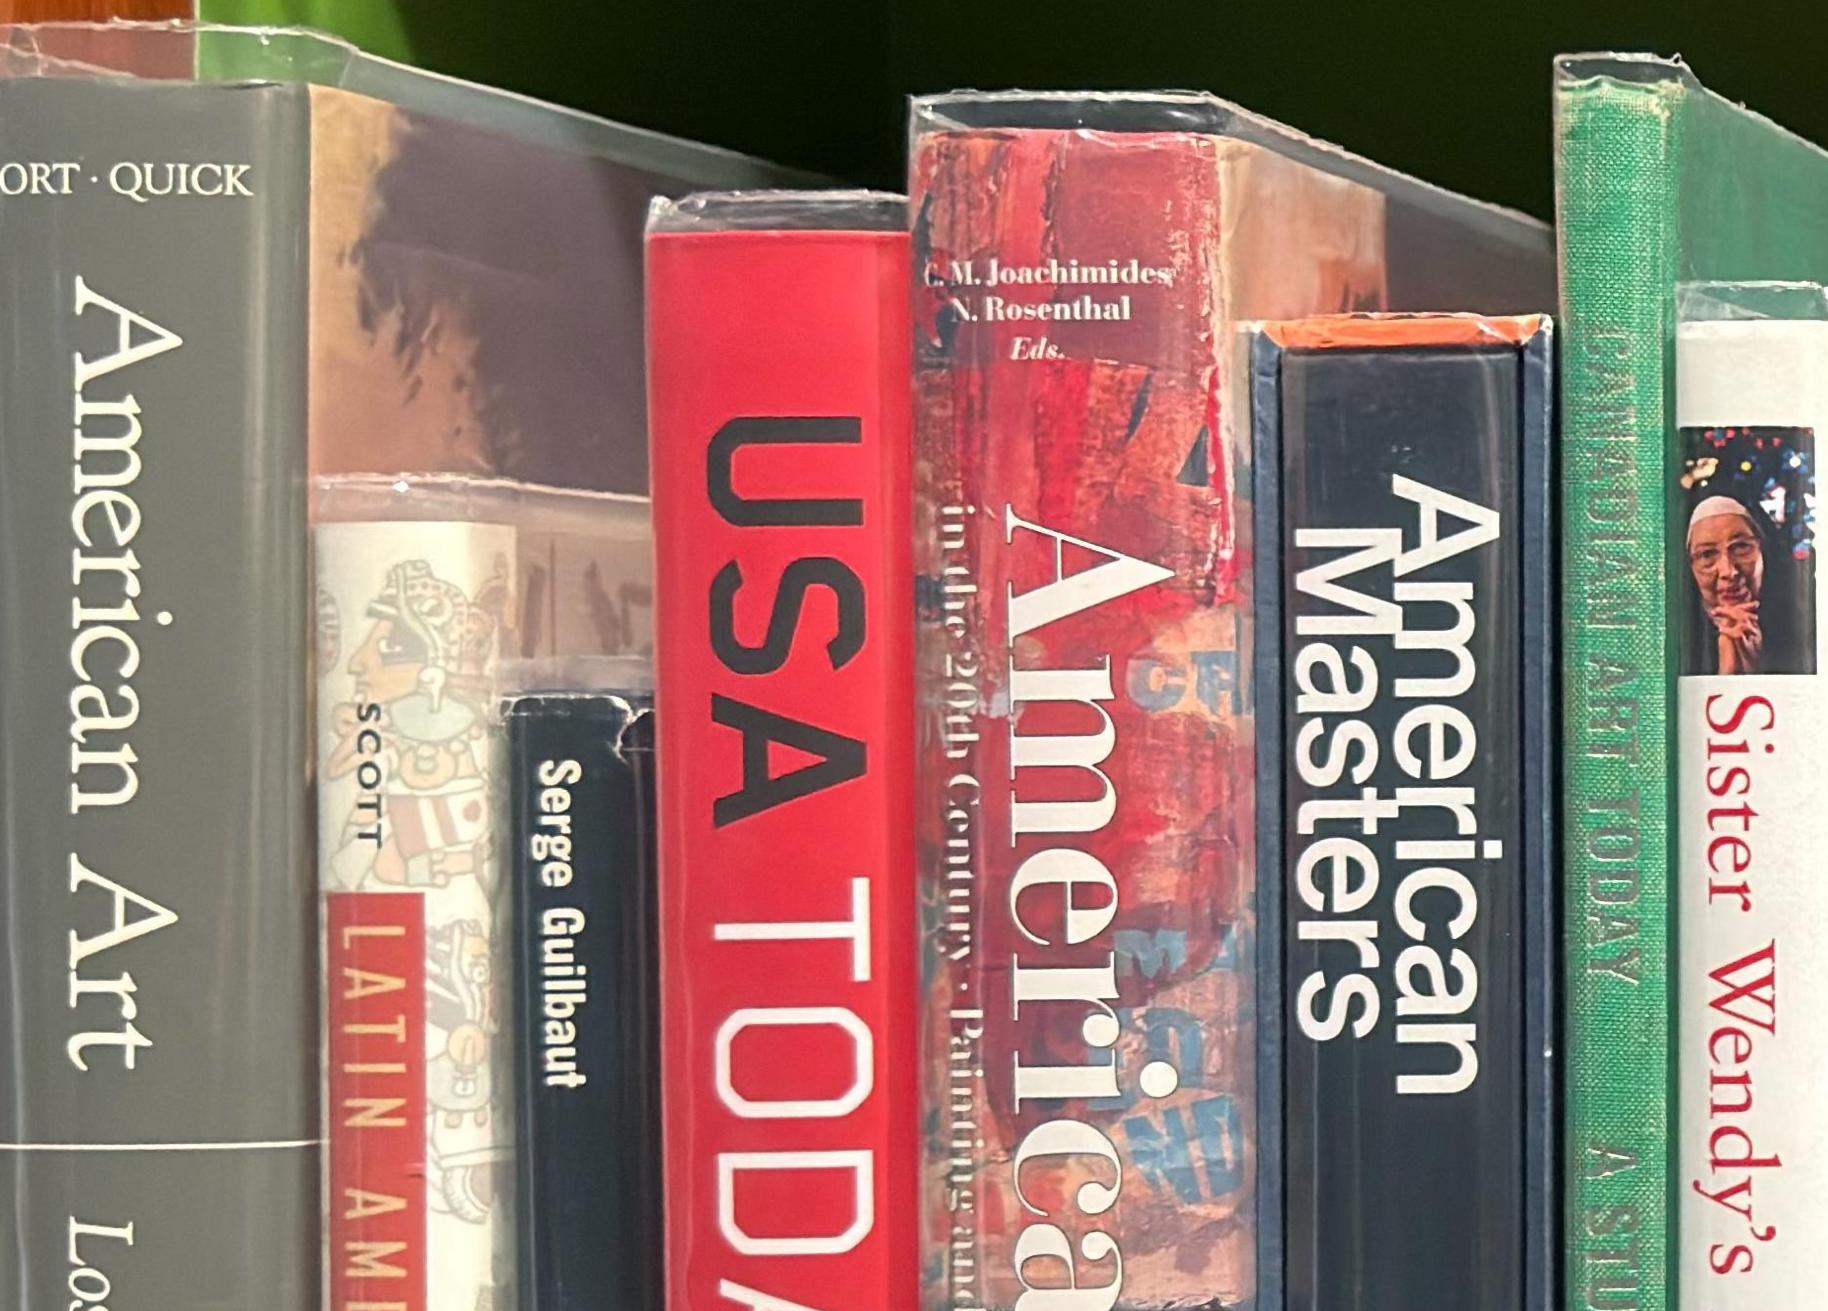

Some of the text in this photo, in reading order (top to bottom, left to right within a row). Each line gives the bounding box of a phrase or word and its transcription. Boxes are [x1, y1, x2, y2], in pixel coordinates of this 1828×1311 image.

[110, 162, 254, 202] QUICK
[986, 296, 1130, 320] Rosenthal
[67, 275, 183, 1071] American Art
[706, 416, 866, 828] USA
[357, 703, 382, 849] SCOTT
[1294, 527, 1404, 1040] Masters
[1389, 473, 1504, 1094] American
[1706, 694, 1774, 912] Sister
[344, 926, 406, 1126] LATIN
[531, 760, 586, 1087] Serge Guilbaut
